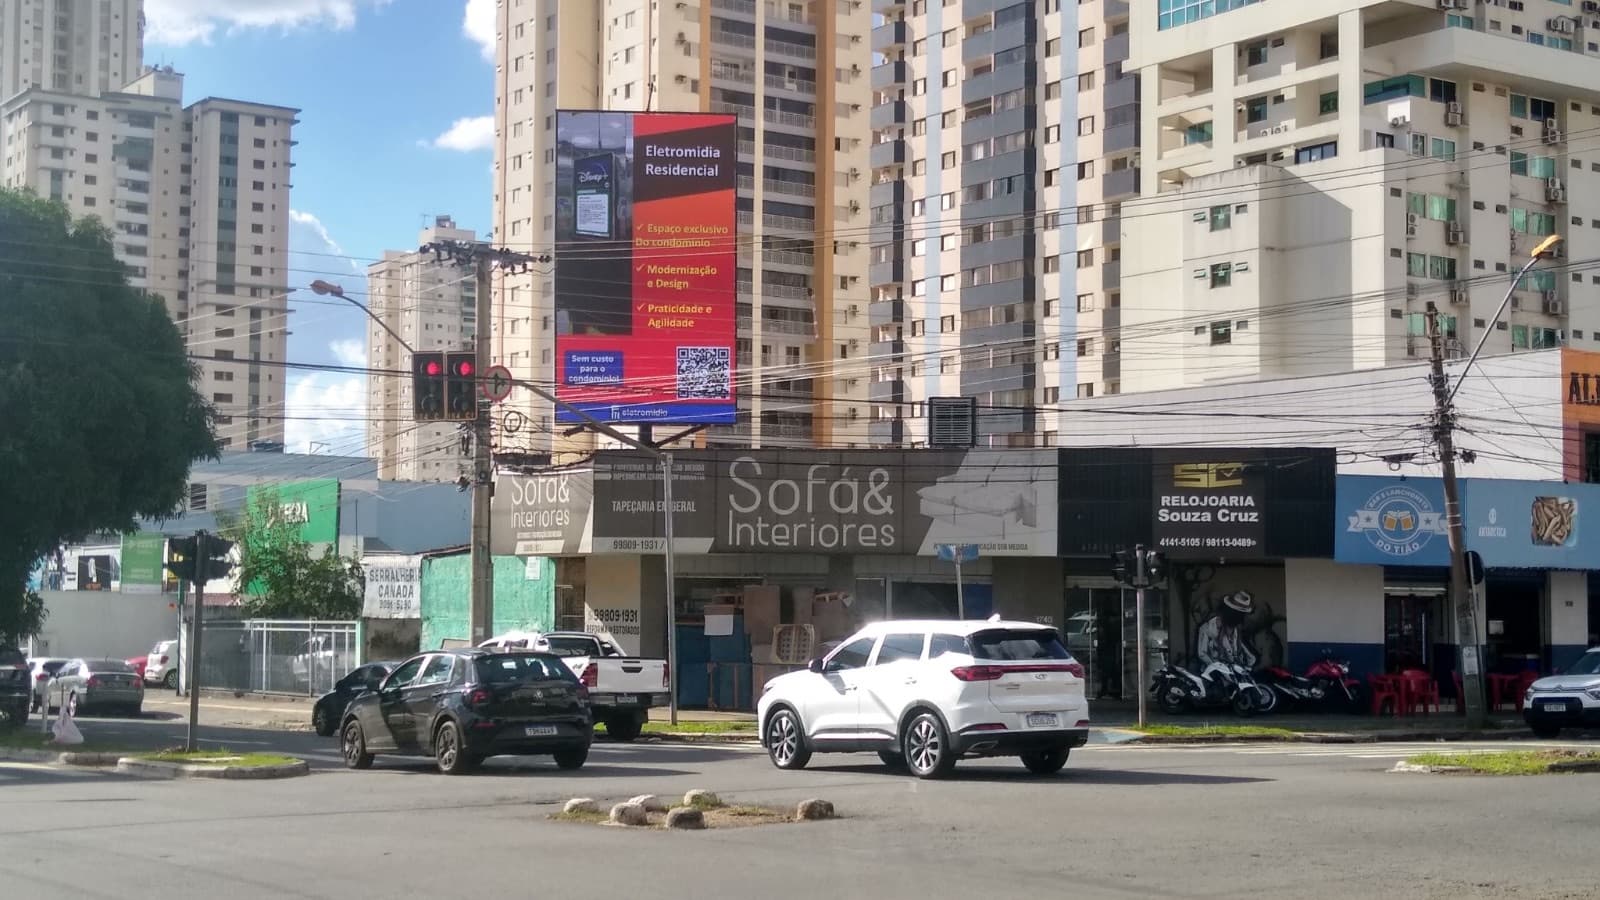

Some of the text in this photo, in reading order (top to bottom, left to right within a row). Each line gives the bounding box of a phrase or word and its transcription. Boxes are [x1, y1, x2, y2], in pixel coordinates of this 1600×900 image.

[646, 145, 721, 158] Eletromidia
[646, 164, 719, 177] Residencial
[648, 224, 728, 235] Espaço exclusivo
[636, 239, 649, 248] Do
[647, 265, 717, 276] Modernização
[656, 279, 688, 290] Design
[648, 304, 704, 314] Praticidade
[648, 319, 694, 329] Agilidade
[572, 355, 614, 363] Sem custo
[580, 366, 599, 374] para
[612, 501, 655, 513] TAPEÇARIA
[1161, 496, 1255, 507] RELOJOARIA
[510, 502, 570, 528] Interiores
[1158, 509, 1259, 522] Souza Cruz
[728, 510, 895, 548] Interiores
[1376, 539, 1391, 552] DO
[378, 584, 414, 599] CANADA
